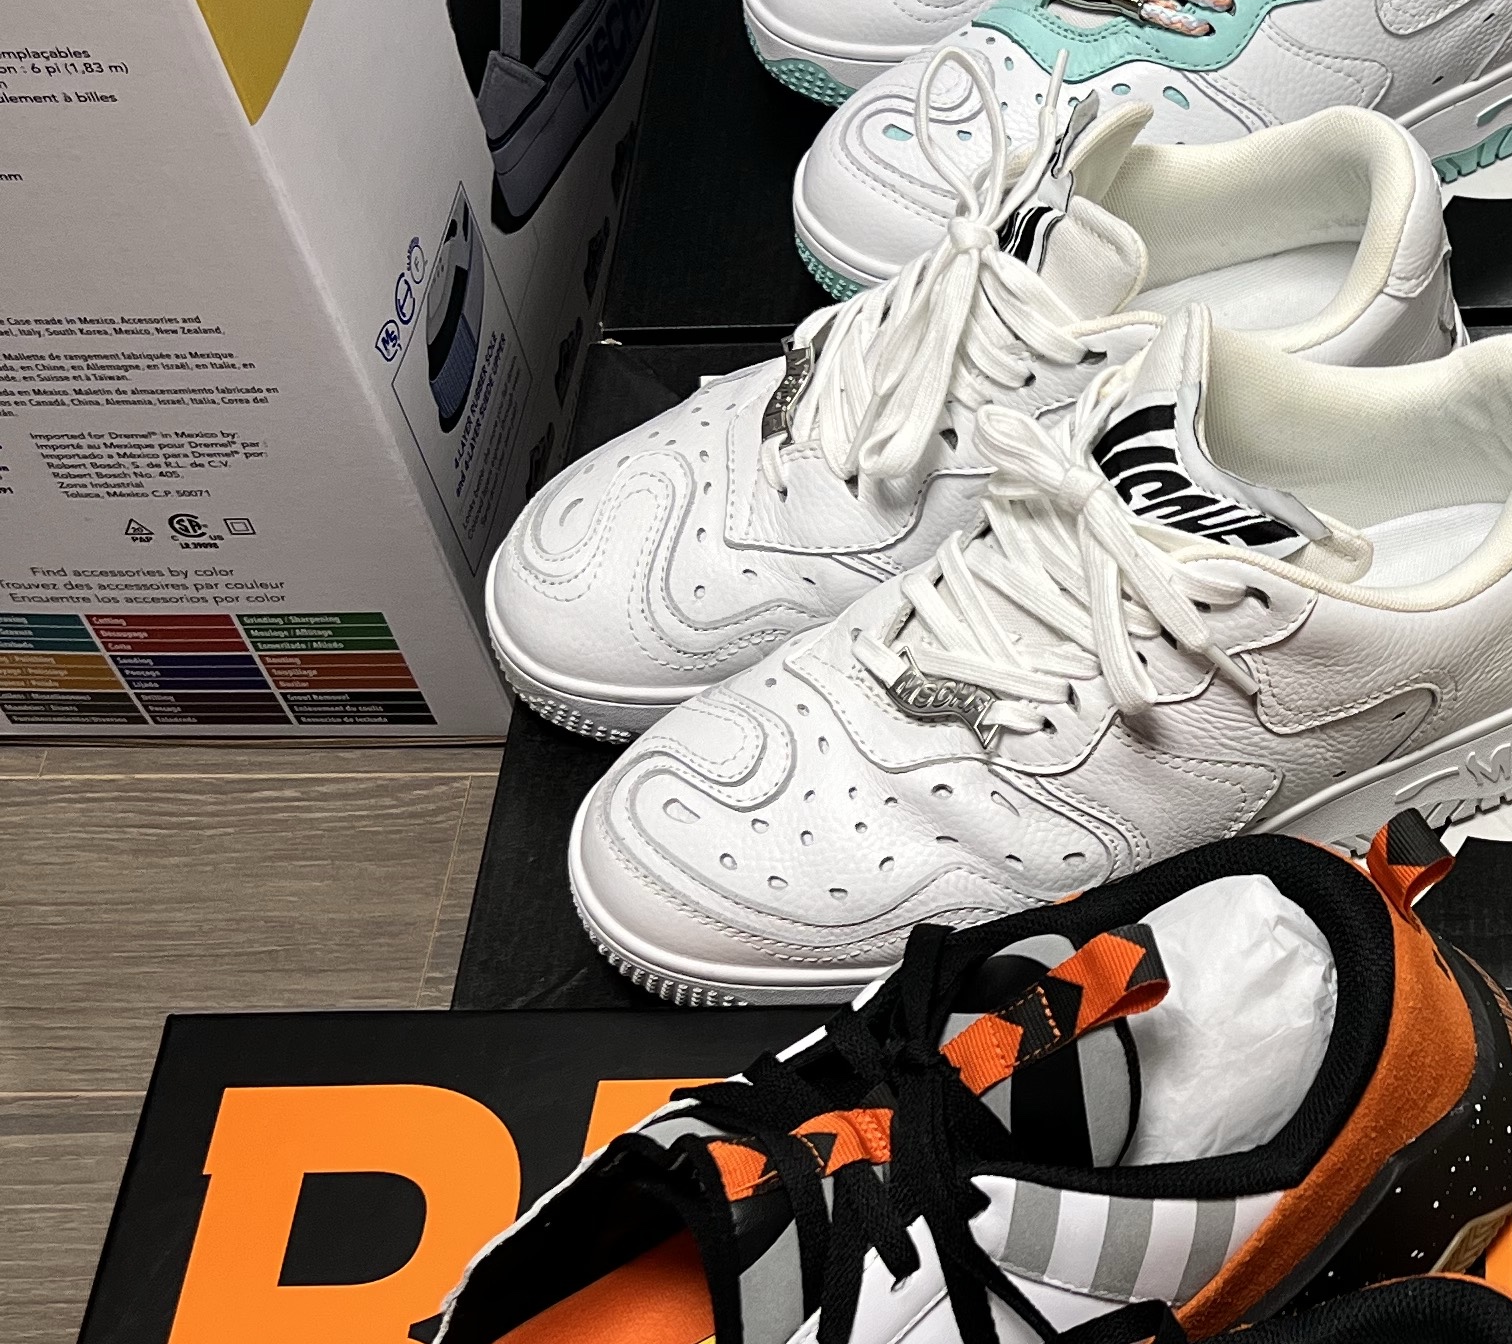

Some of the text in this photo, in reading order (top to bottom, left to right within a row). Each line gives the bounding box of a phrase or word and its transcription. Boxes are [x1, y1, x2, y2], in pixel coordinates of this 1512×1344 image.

[0, 47, 91, 61] mplaçables
[75, 91, 118, 103] billes
[7, 317, 32, 325] Case
[33, 317, 63, 325] made
[121, 316, 180, 325] Accessories
[181, 315, 202, 324] and
[45, 327, 78, 336] South
[155, 327, 179, 335] New
[221, 396, 251, 404] Corea
[252, 396, 269, 404] del
[30, 432, 86, 441] Imported
[103, 441, 155, 450] Mexique
[158, 442, 186, 450] pour
[241, 441, 260, 450] par
[41, 452, 104, 461] Importado
[163, 452, 190, 460] para
[95, 471, 132, 479] Bosch
[57, 481, 88, 489] Zona
[30, 567, 235, 579] Find accessories by color
[63, 580, 94, 590] des
[98, 581, 189, 591] accessoires
[193, 582, 220, 592] par
[224, 579, 285, 590] couleur
[9, 592, 286, 606] Encuentre los accesorios por color
